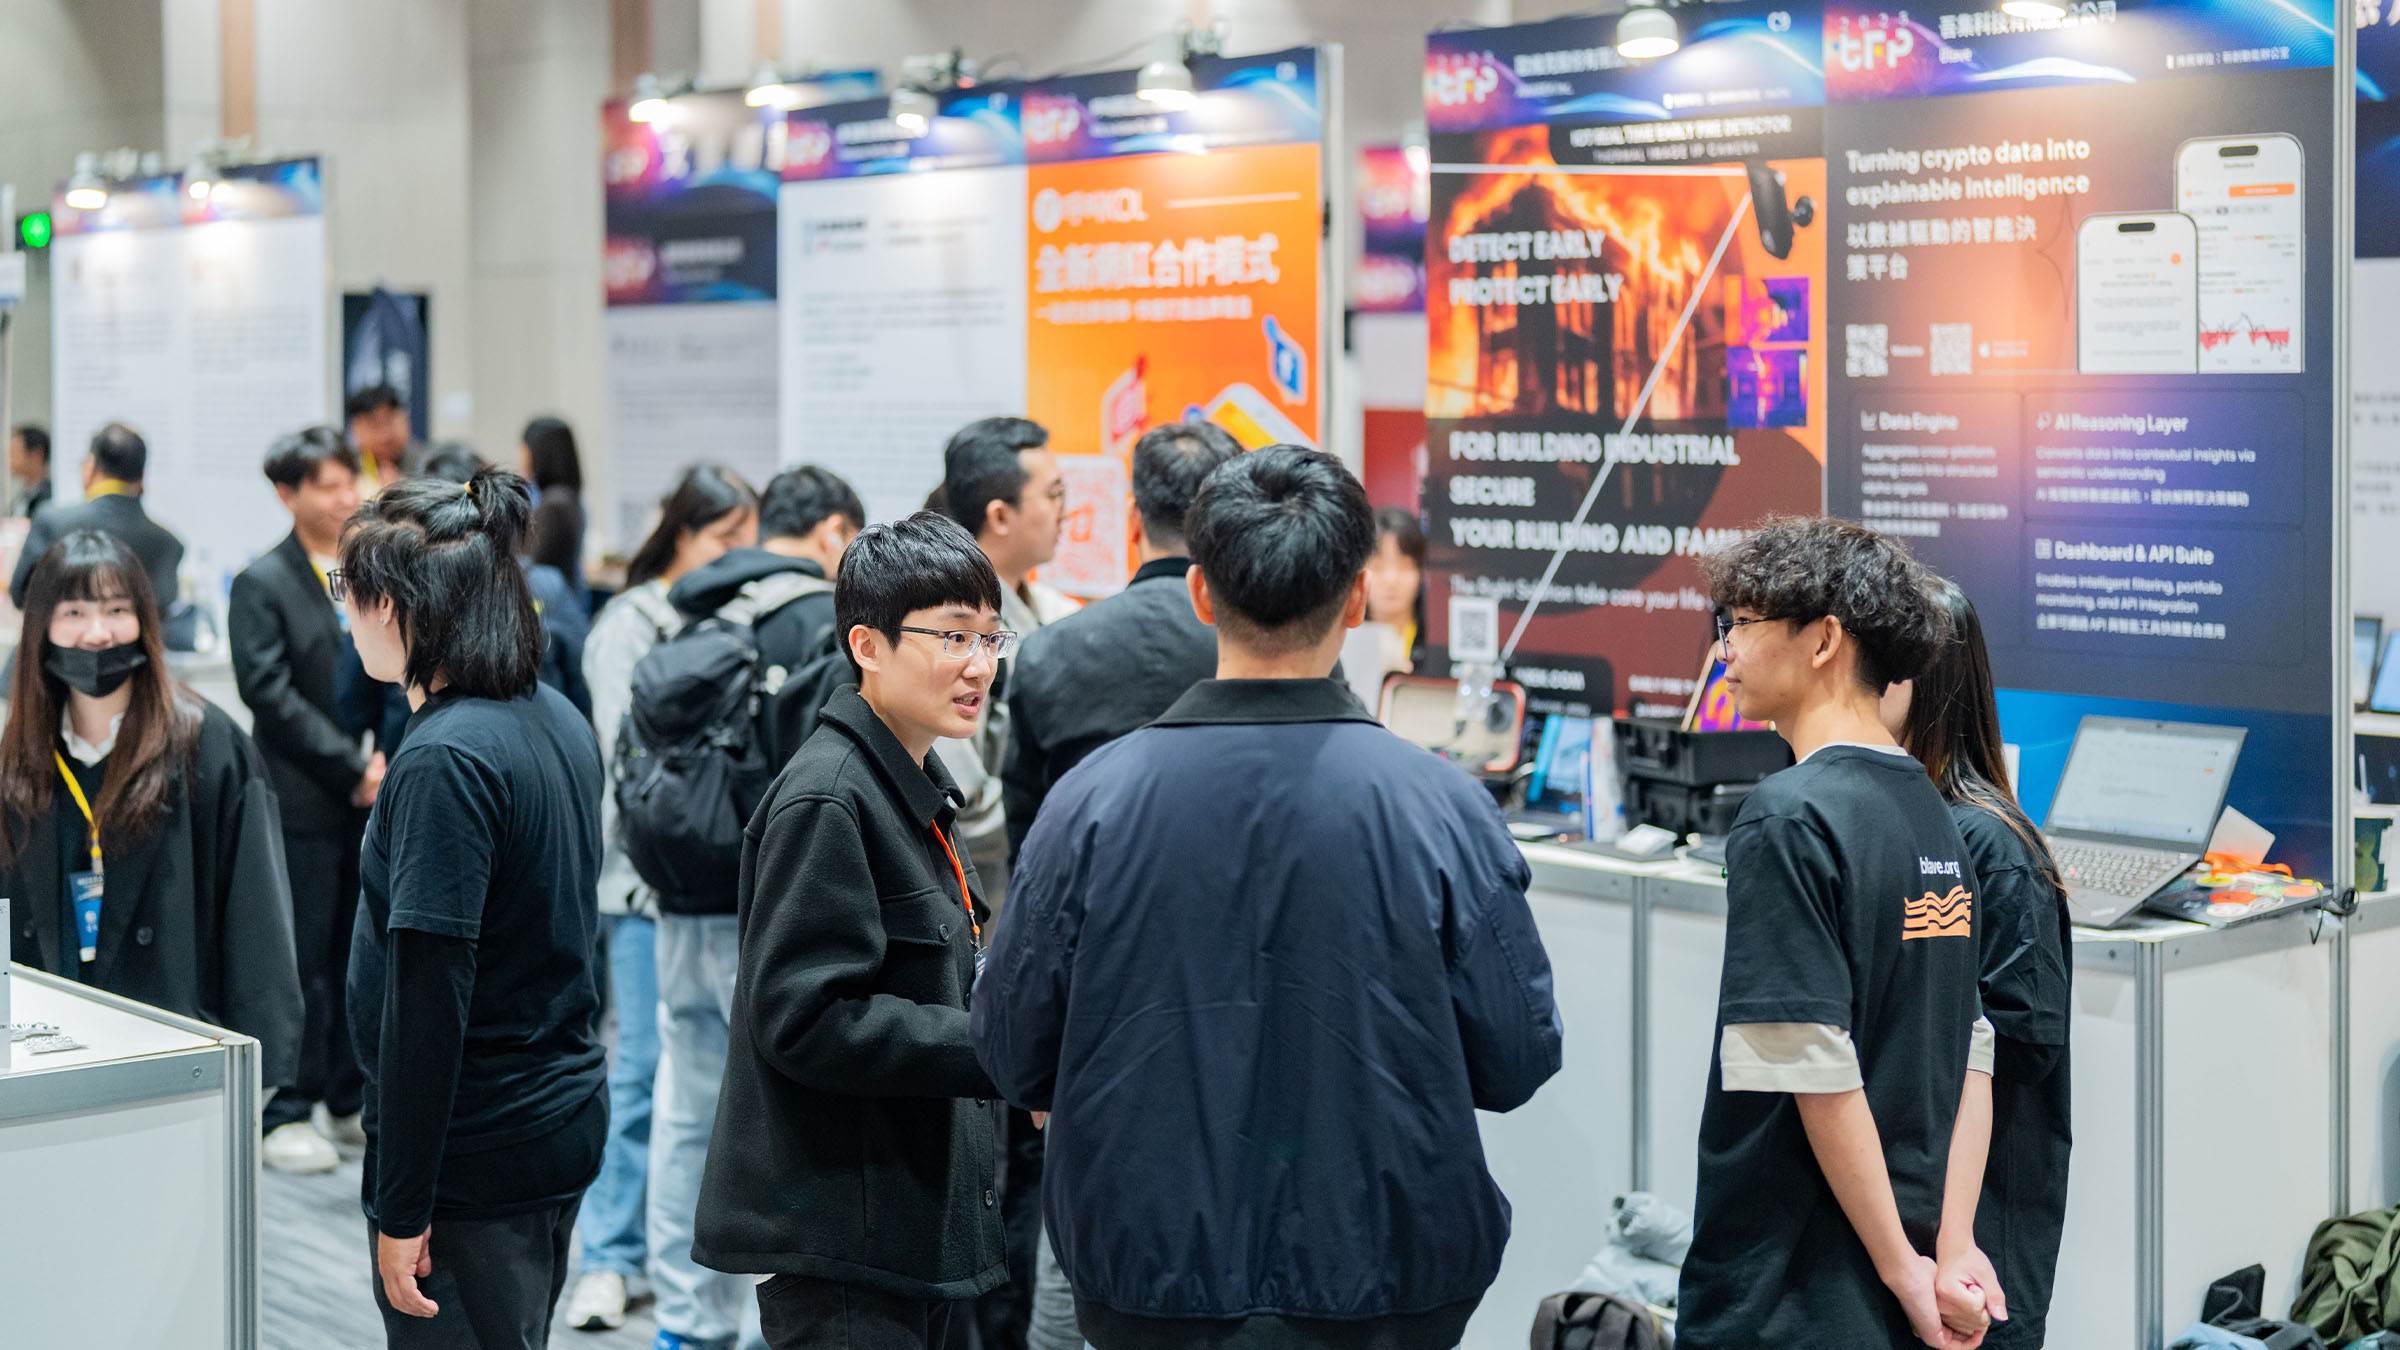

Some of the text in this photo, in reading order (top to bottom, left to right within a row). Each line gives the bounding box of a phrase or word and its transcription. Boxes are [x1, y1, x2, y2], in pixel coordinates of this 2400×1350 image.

[1723, 115, 1792, 137] DETECTOR
[1846, 138, 2090, 174] Turning crypto data into
[1846, 174, 2090, 209] explainable intelligence
[1449, 230, 1607, 263] DETECT EARLY
[1449, 276, 1550, 306] PROTECT
[1551, 273, 1625, 305] EARLY
[1879, 411, 1959, 434] Data Engine
[2055, 414, 2189, 436] AI Reasoning Layer
[1449, 431, 1740, 466] FOR BUILDING INDUSTRIAL
[2134, 448, 2192, 462] contextual
[2193, 447, 2236, 465] insights
[2237, 449, 2256, 463] via
[2087, 466, 2166, 484] understanding
[1449, 476, 1536, 507] SECURE
[1449, 518, 1513, 549] YOUR
[1515, 519, 1619, 553] BUILDING
[1620, 524, 1673, 556] AND
[2054, 540, 2215, 565] Dashboard & API Suite
[2036, 572, 2077, 588] Enables
[2079, 574, 2130, 593] intelligent
[2176, 578, 2223, 596] portfolio
[1609, 588, 1644, 606] care
[1646, 589, 1677, 613] your
[2096, 596, 2120, 610] and
[2121, 596, 2138, 611] API
[2139, 598, 2199, 616] integration
[1919, 856, 1961, 879] blave.org
